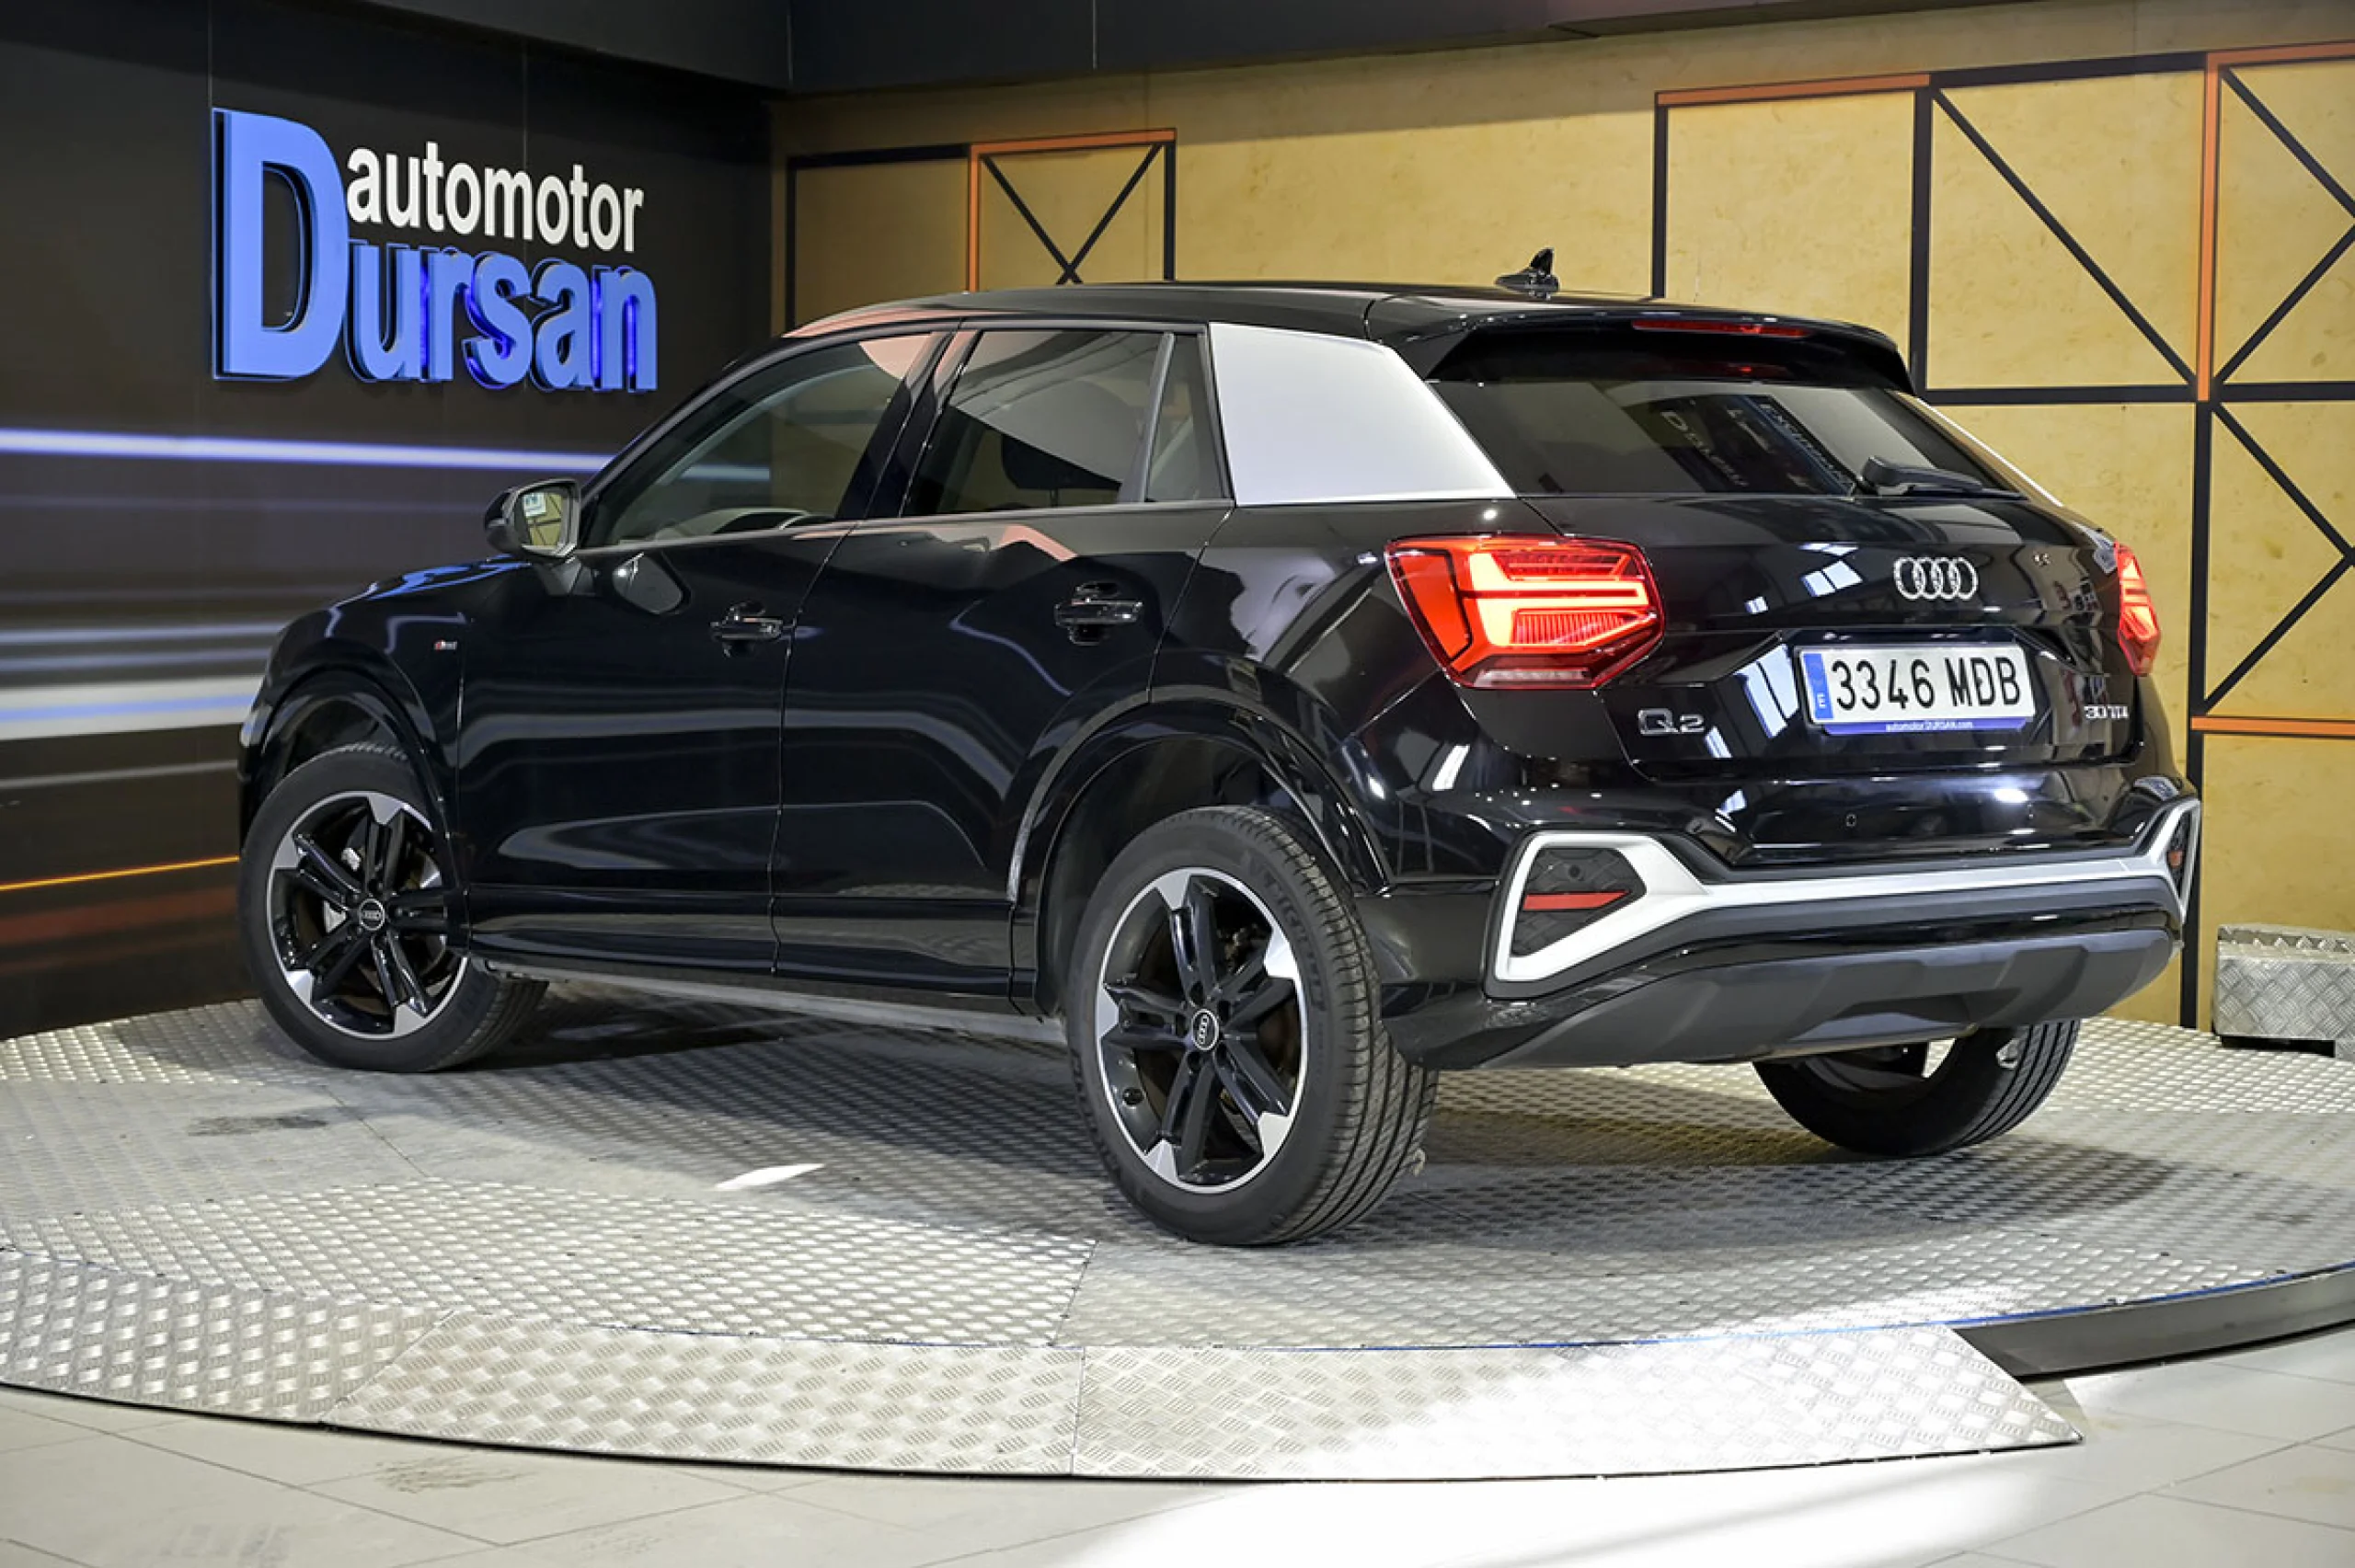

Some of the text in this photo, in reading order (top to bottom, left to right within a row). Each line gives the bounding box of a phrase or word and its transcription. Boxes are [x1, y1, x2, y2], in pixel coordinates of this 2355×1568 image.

[347, 140, 644, 252] automotor
[212, 107, 659, 393] Dursan
[1637, 707, 1706, 736] Q2
[1832, 656, 2021, 710] 3346 MDB
